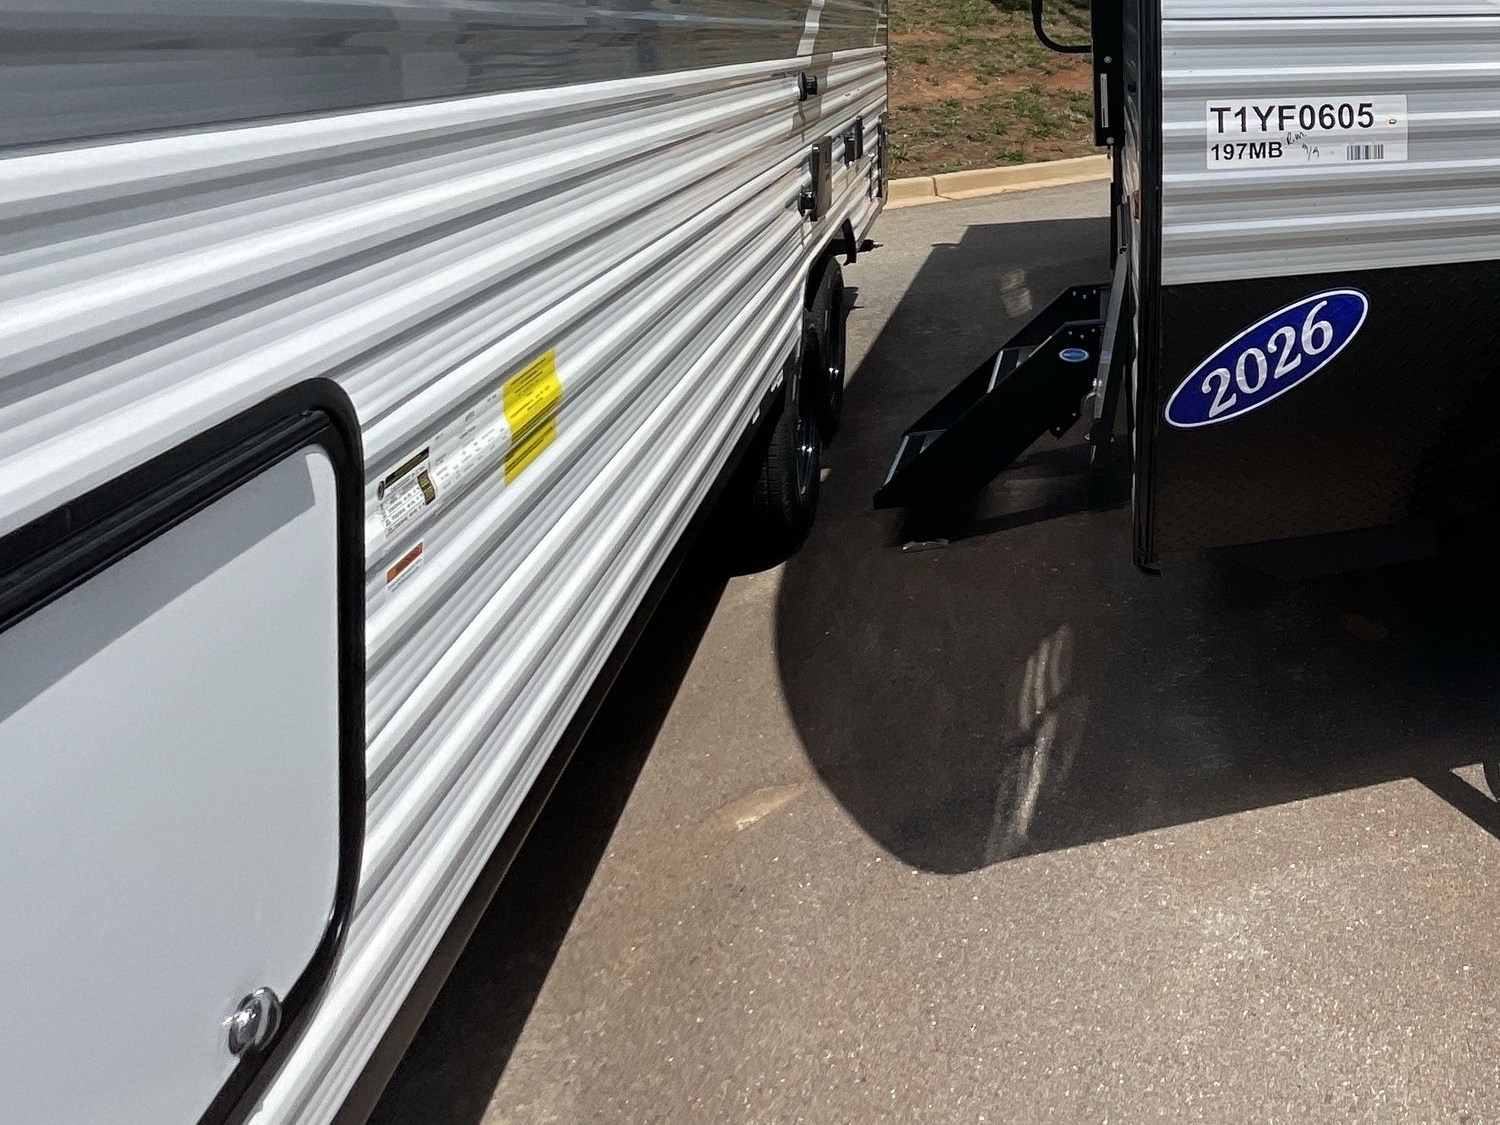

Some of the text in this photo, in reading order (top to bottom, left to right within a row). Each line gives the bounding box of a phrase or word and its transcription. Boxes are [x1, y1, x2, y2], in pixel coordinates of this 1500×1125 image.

[1210, 103, 1375, 133] T1YF0605
[1211, 141, 1284, 161] 197MB
[1202, 300, 1334, 418] 2026
